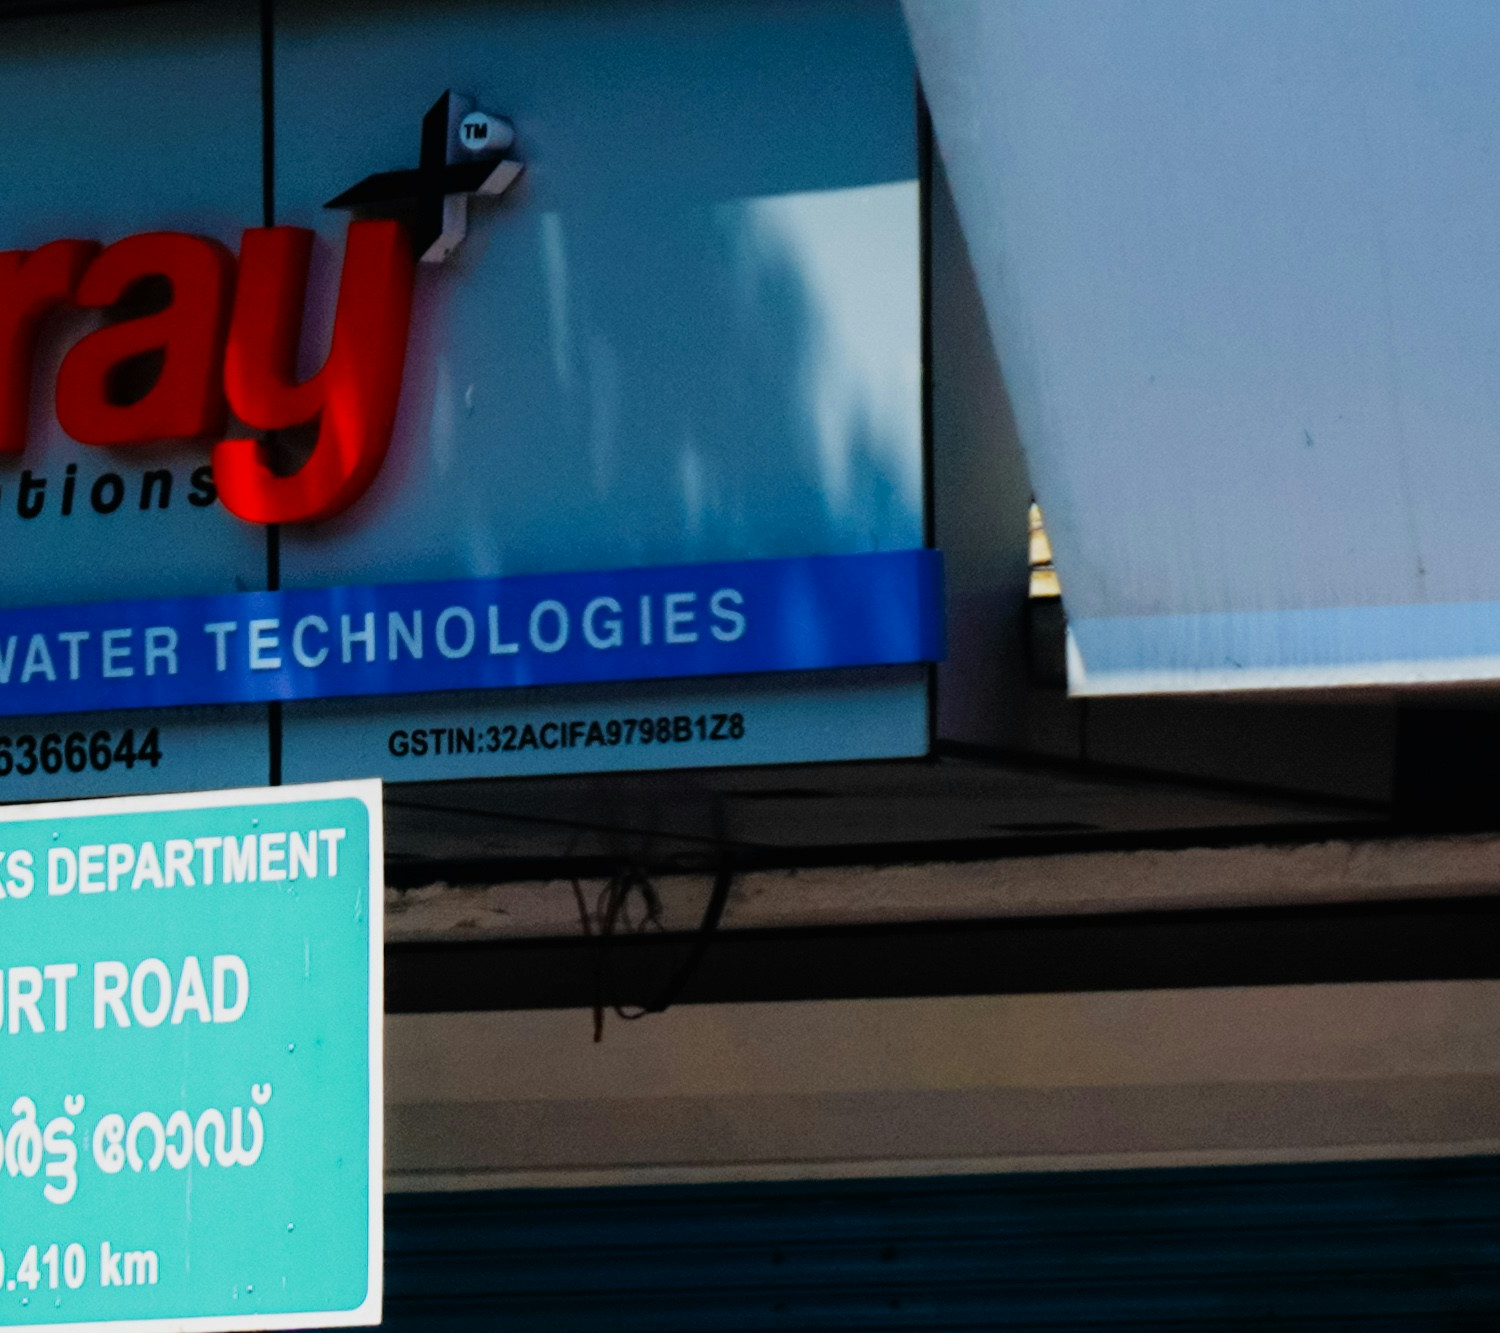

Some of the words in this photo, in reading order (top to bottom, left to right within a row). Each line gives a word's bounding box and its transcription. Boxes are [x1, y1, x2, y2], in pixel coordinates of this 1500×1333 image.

[463, 123, 488, 141] TM
[205, 590, 743, 671] TECHNOLOGIES
[388, 712, 745, 757] GSTIN:32ACIFA9798B1Z8
[49, 829, 345, 895] DEPARTMENT
[94, 955, 248, 1029] ROAD
[93, 1084, 271, 1173] റോഡ്
[101, 1242, 157, 1286] km
